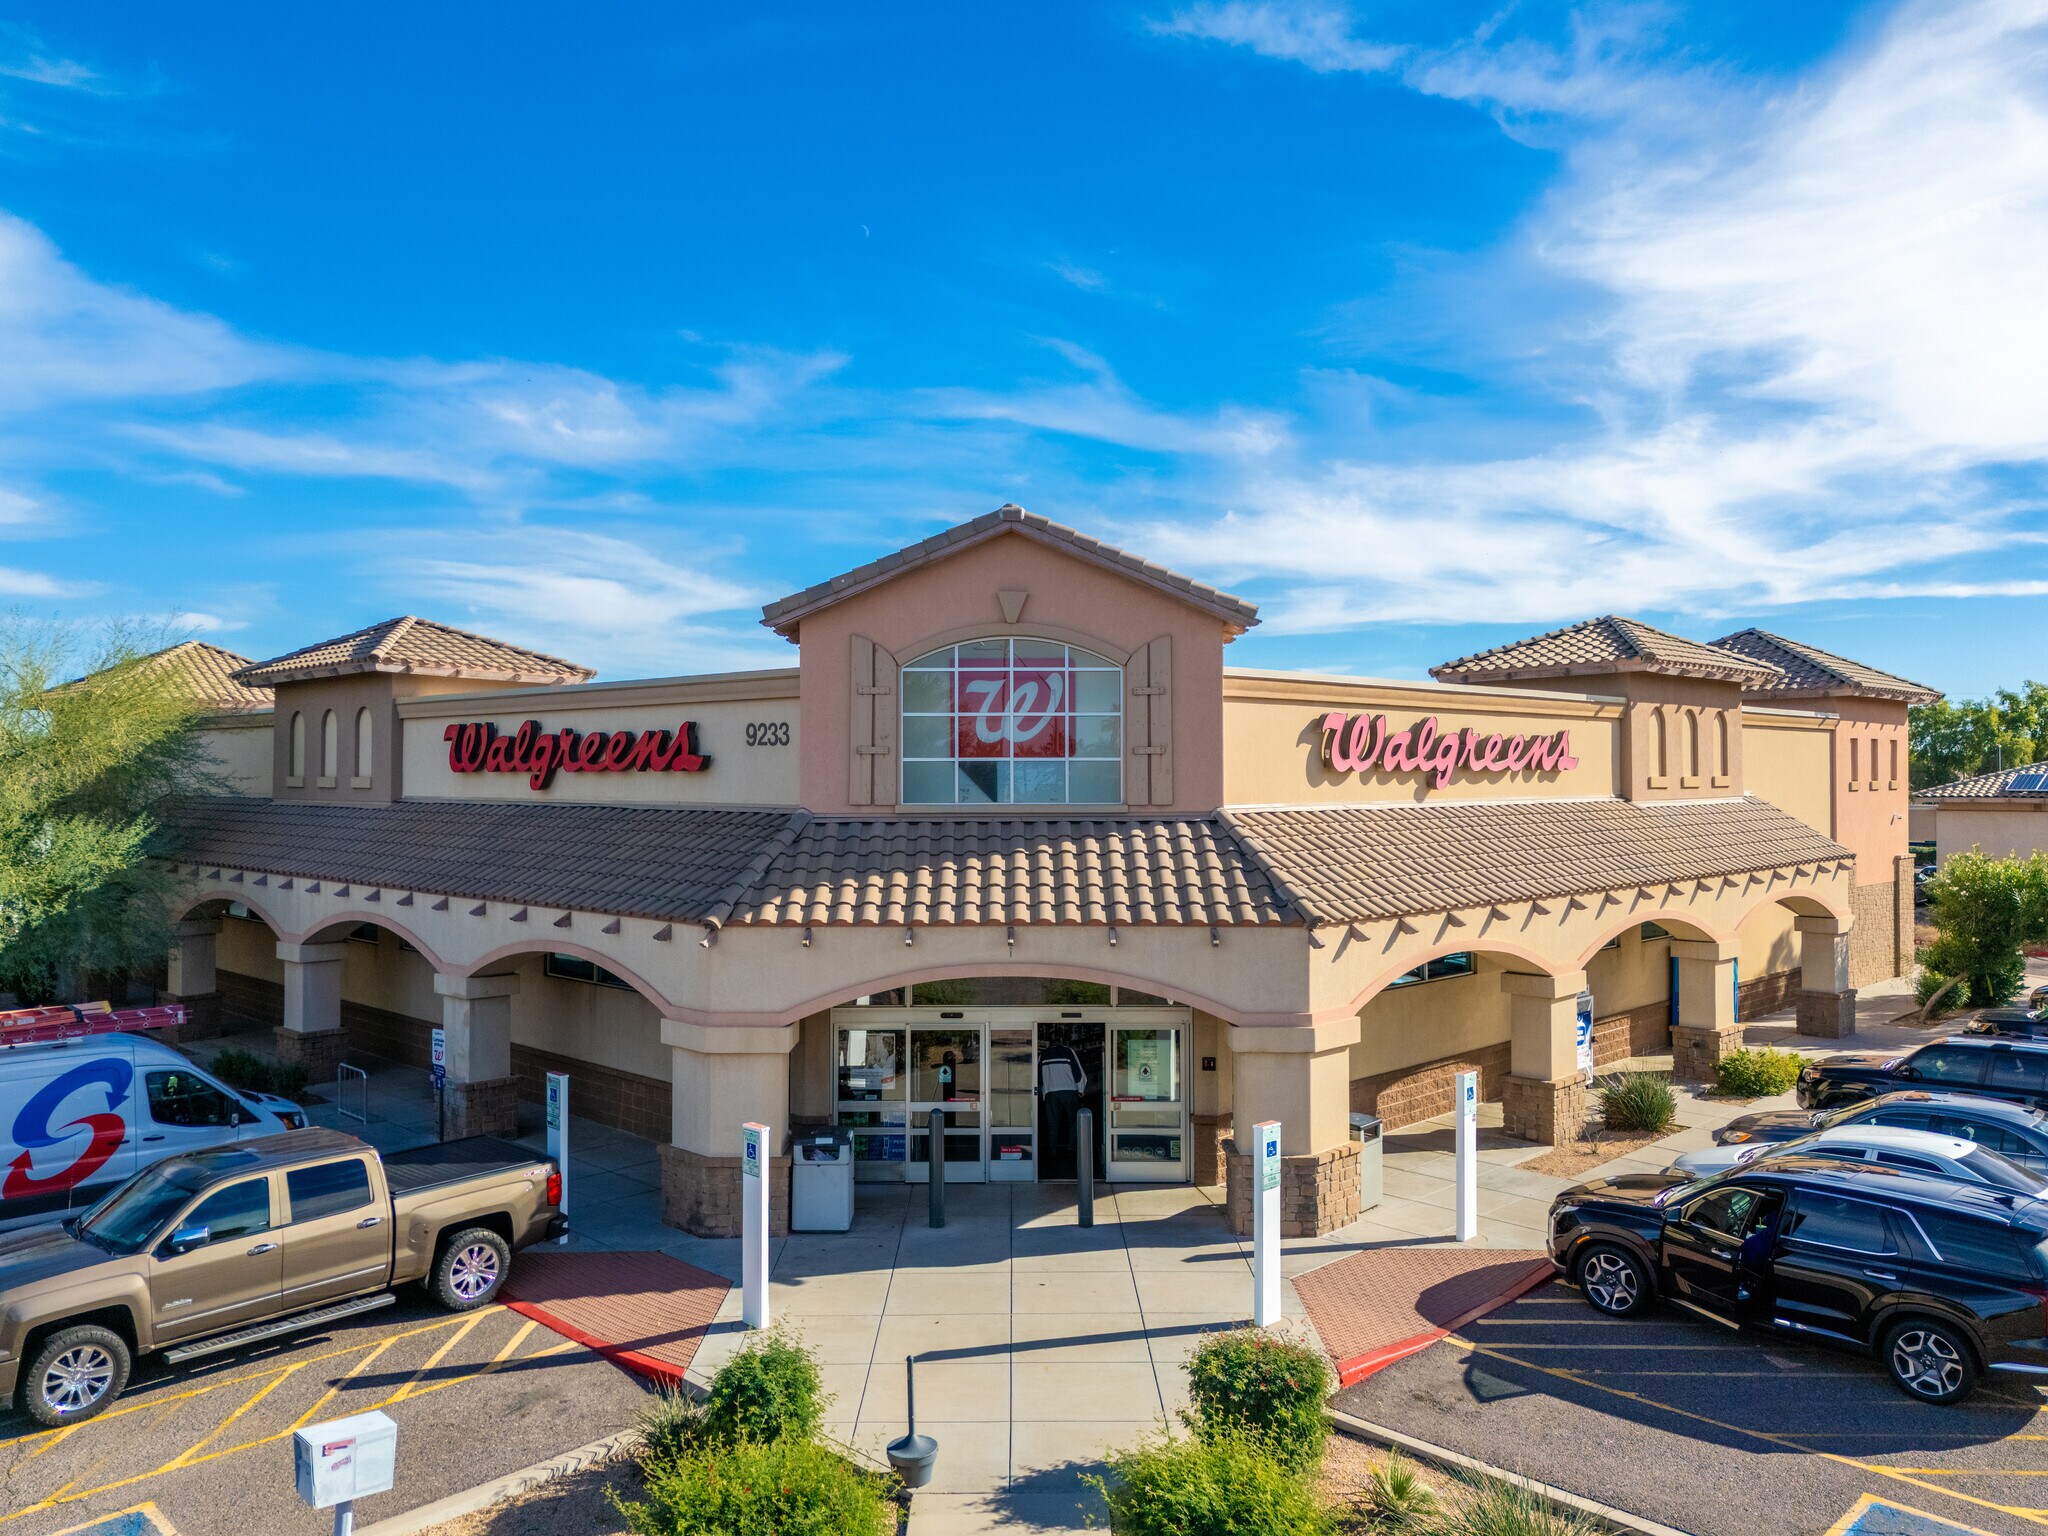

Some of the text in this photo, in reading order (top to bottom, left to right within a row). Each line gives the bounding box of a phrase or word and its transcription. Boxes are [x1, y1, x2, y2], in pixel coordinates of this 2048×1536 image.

[745, 722, 790, 747] 9233
[965, 672, 1064, 744] W
[443, 719, 711, 791] Walgreens
[1319, 712, 1579, 790] Walgreens
